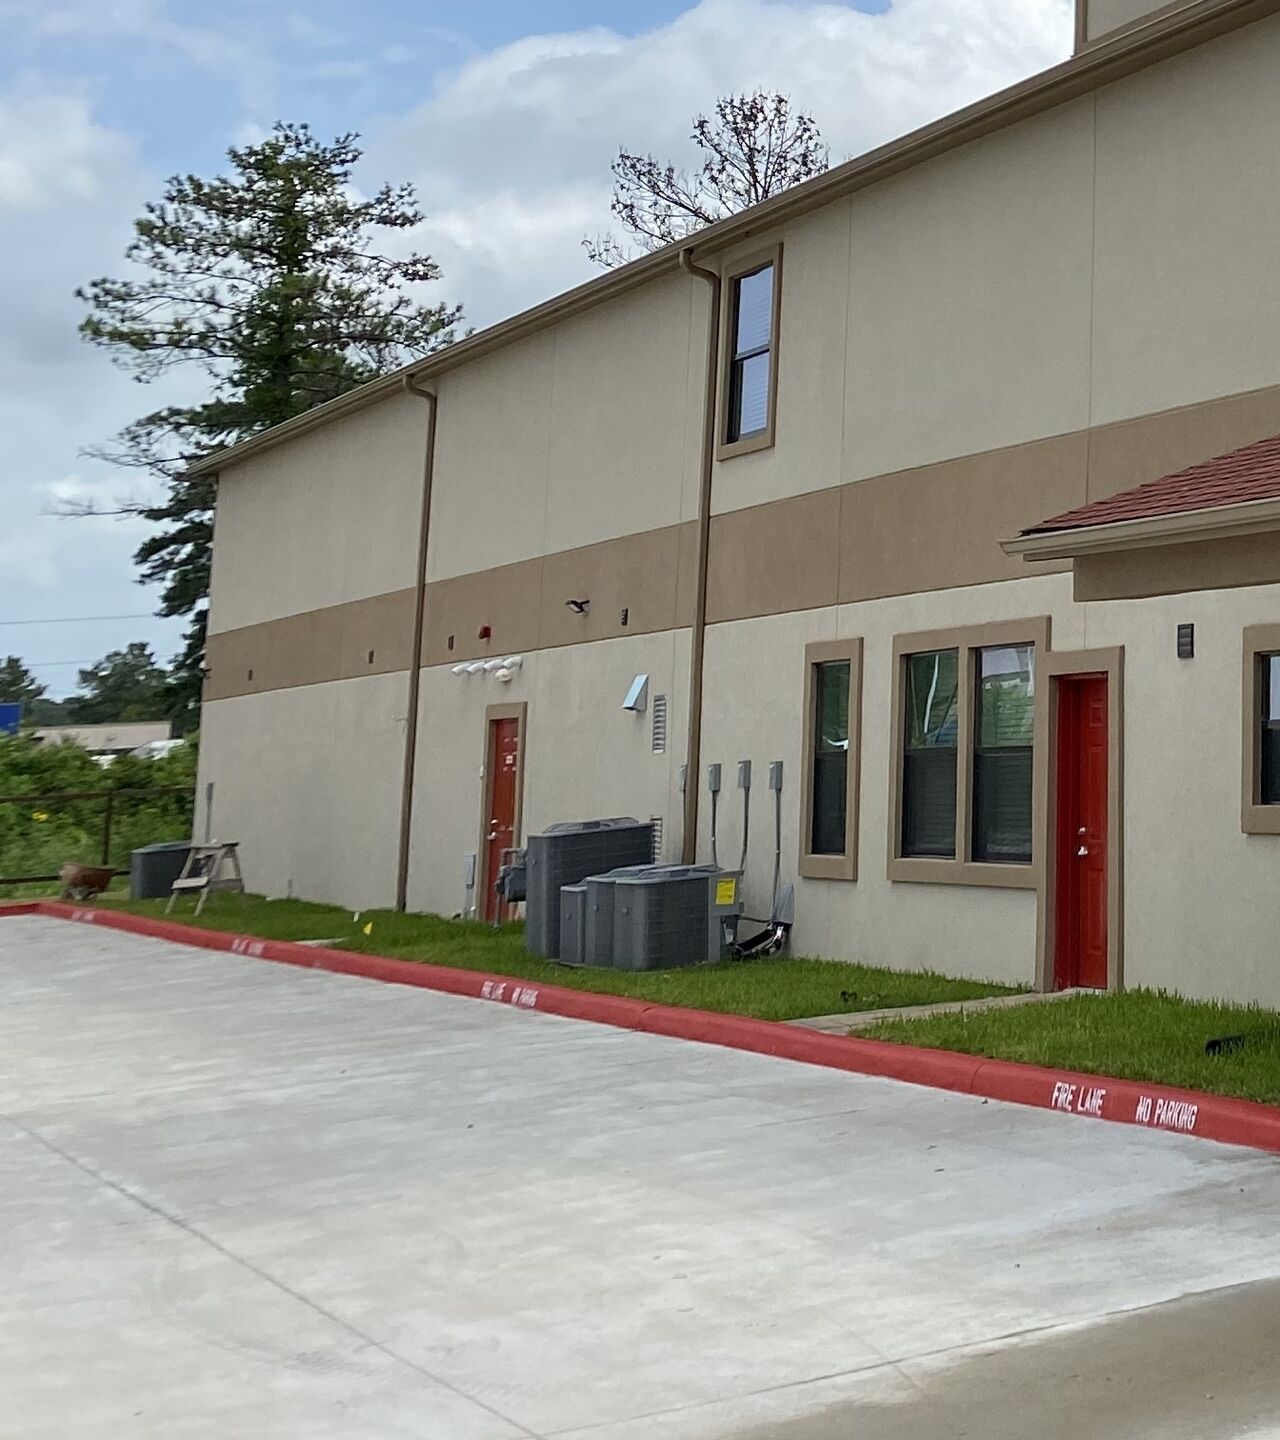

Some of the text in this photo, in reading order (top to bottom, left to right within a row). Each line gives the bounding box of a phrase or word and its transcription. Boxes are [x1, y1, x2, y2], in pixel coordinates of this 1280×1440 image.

[1051, 1081, 1106, 1116] FIRE LANE
[1135, 1096, 1198, 1130] NO PARKING
